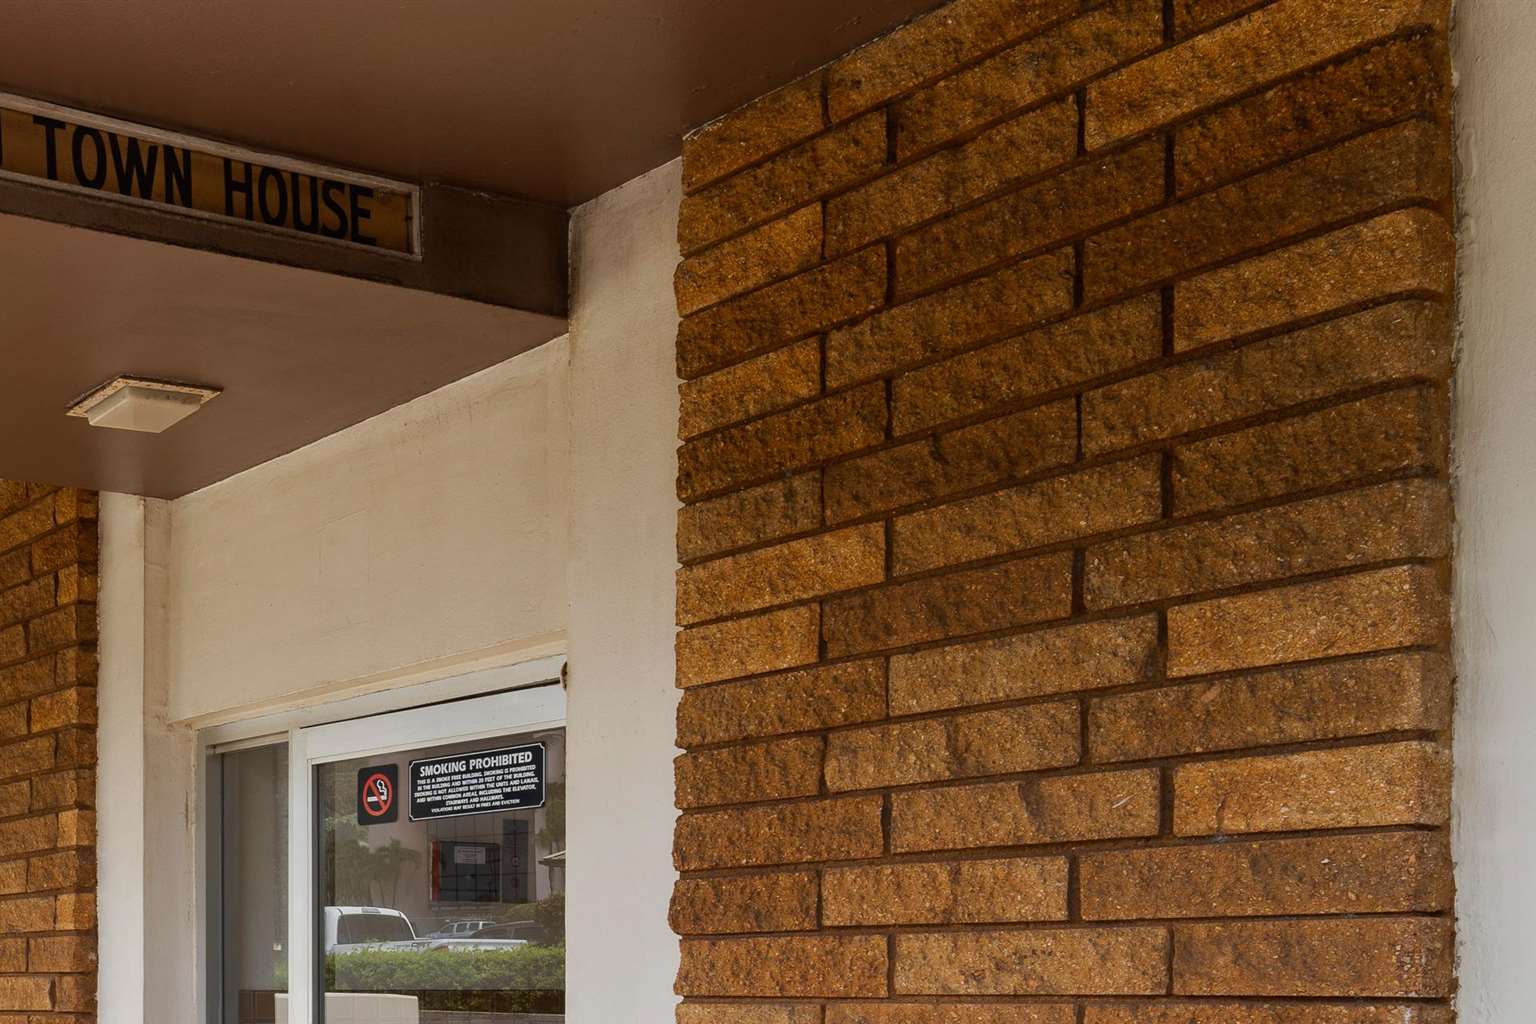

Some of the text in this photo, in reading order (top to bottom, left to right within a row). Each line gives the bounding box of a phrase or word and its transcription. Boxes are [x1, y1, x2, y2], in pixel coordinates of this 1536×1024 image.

[32, 115, 194, 209] TOWN
[223, 157, 377, 247] HOUSE
[420, 752, 532, 777] SMOKING PROHIBITED
